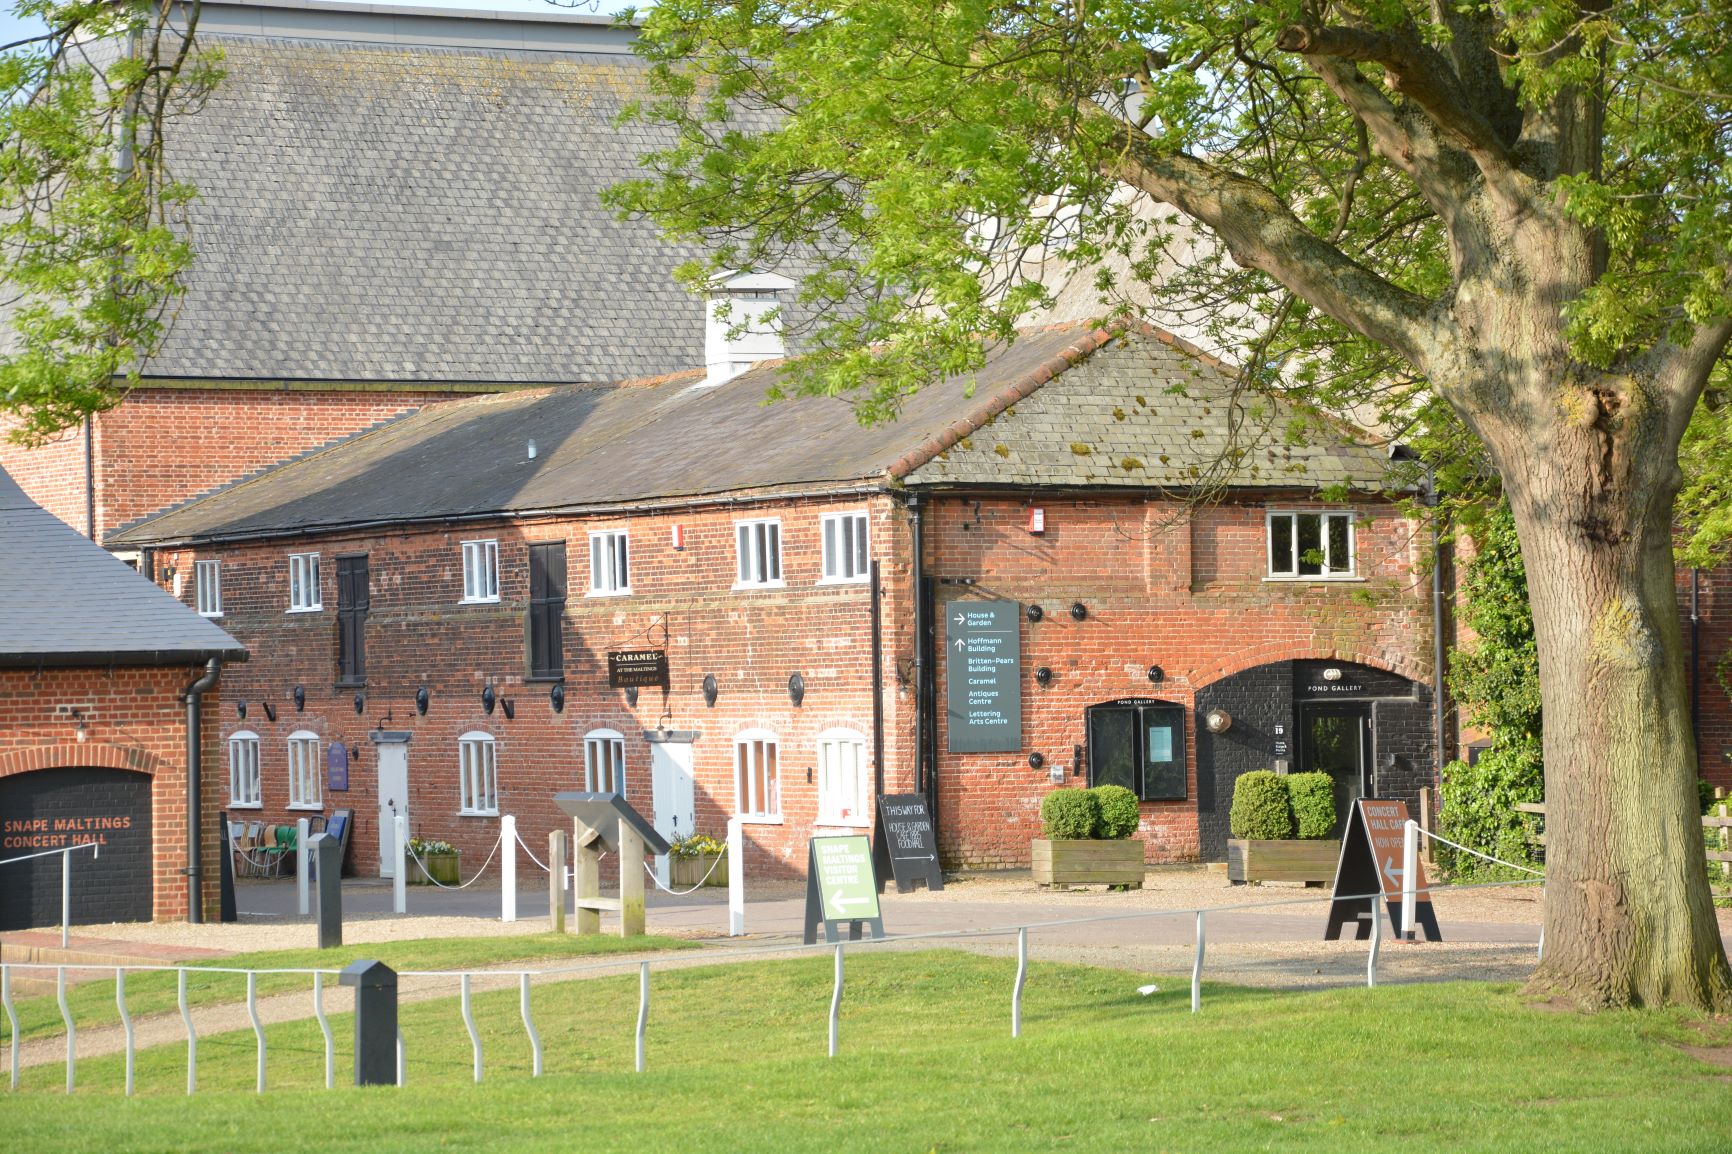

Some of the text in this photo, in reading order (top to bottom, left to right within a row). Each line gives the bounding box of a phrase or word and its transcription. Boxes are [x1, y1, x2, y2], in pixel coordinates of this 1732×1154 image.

[967, 645, 996, 653] Building
[616, 653, 658, 661] CARAMEL
[968, 665, 996, 673] Building
[968, 710, 1001, 718] Lettering
[1275, 727, 1283, 735] 19
[913, 804, 925, 815] FOR
[1367, 806, 1399, 817] CONCERT
[4, 816, 132, 833] SNAPE MALTINGS
[911, 821, 930, 832] GARDEN
[1370, 818, 1389, 830] HALL
[3, 832, 107, 849] CONCERT HALL
[1391, 837, 1404, 848] OPE
[820, 844, 849, 854] SNAPE
[822, 854, 865, 864] MALTINGS
[823, 864, 858, 875] VISITOR
[825, 875, 859, 885] CENTRE
